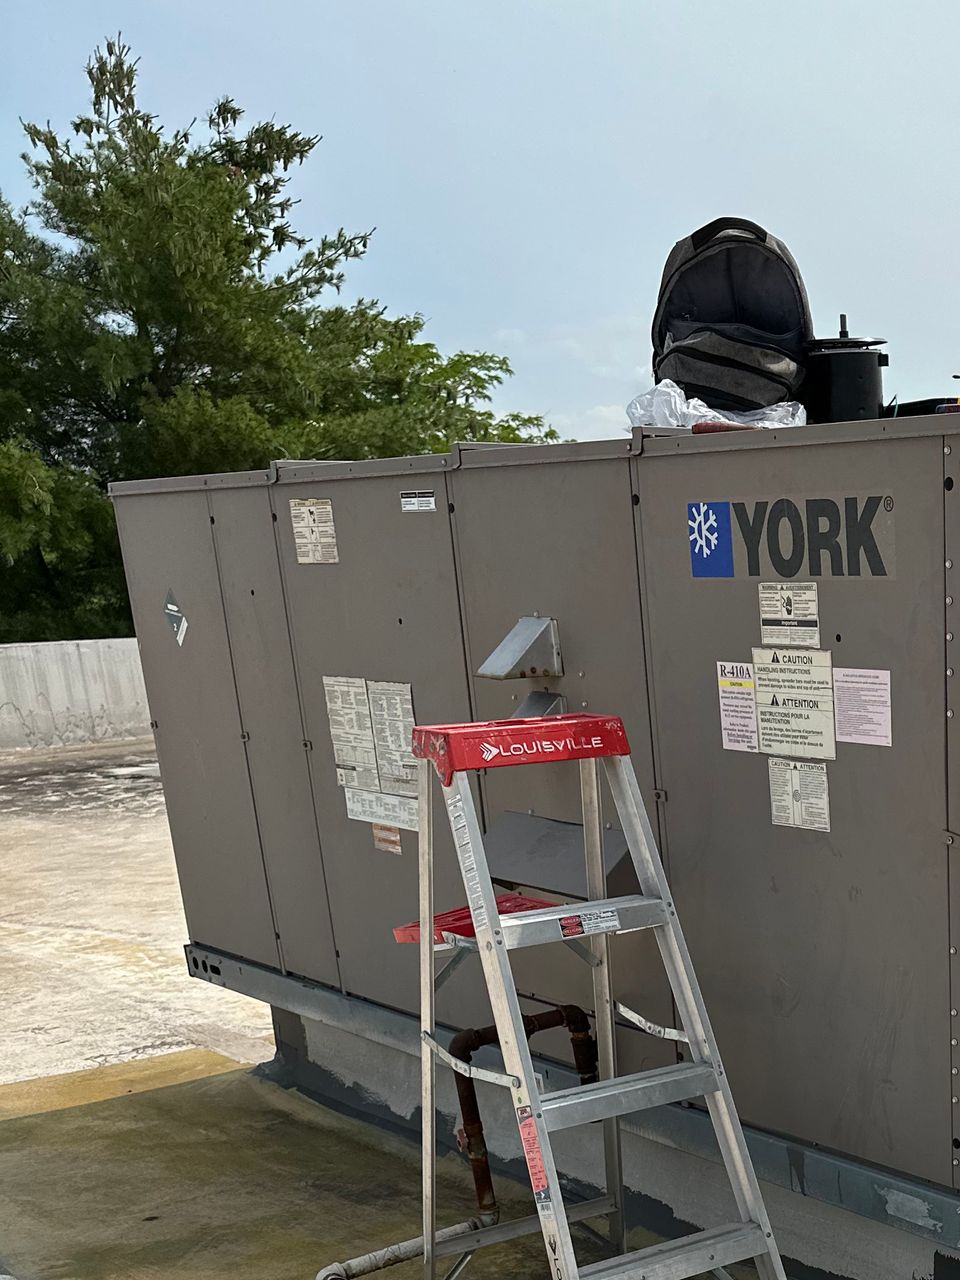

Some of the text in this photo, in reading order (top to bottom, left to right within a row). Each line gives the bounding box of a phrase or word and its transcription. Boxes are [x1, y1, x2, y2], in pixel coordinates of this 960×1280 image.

[782, 654, 812, 664] CAUTION
[720, 664, 752, 678] R-410A
[782, 698, 818, 708] ATTENTION
[500, 736, 603, 756] LOUISVILLE
